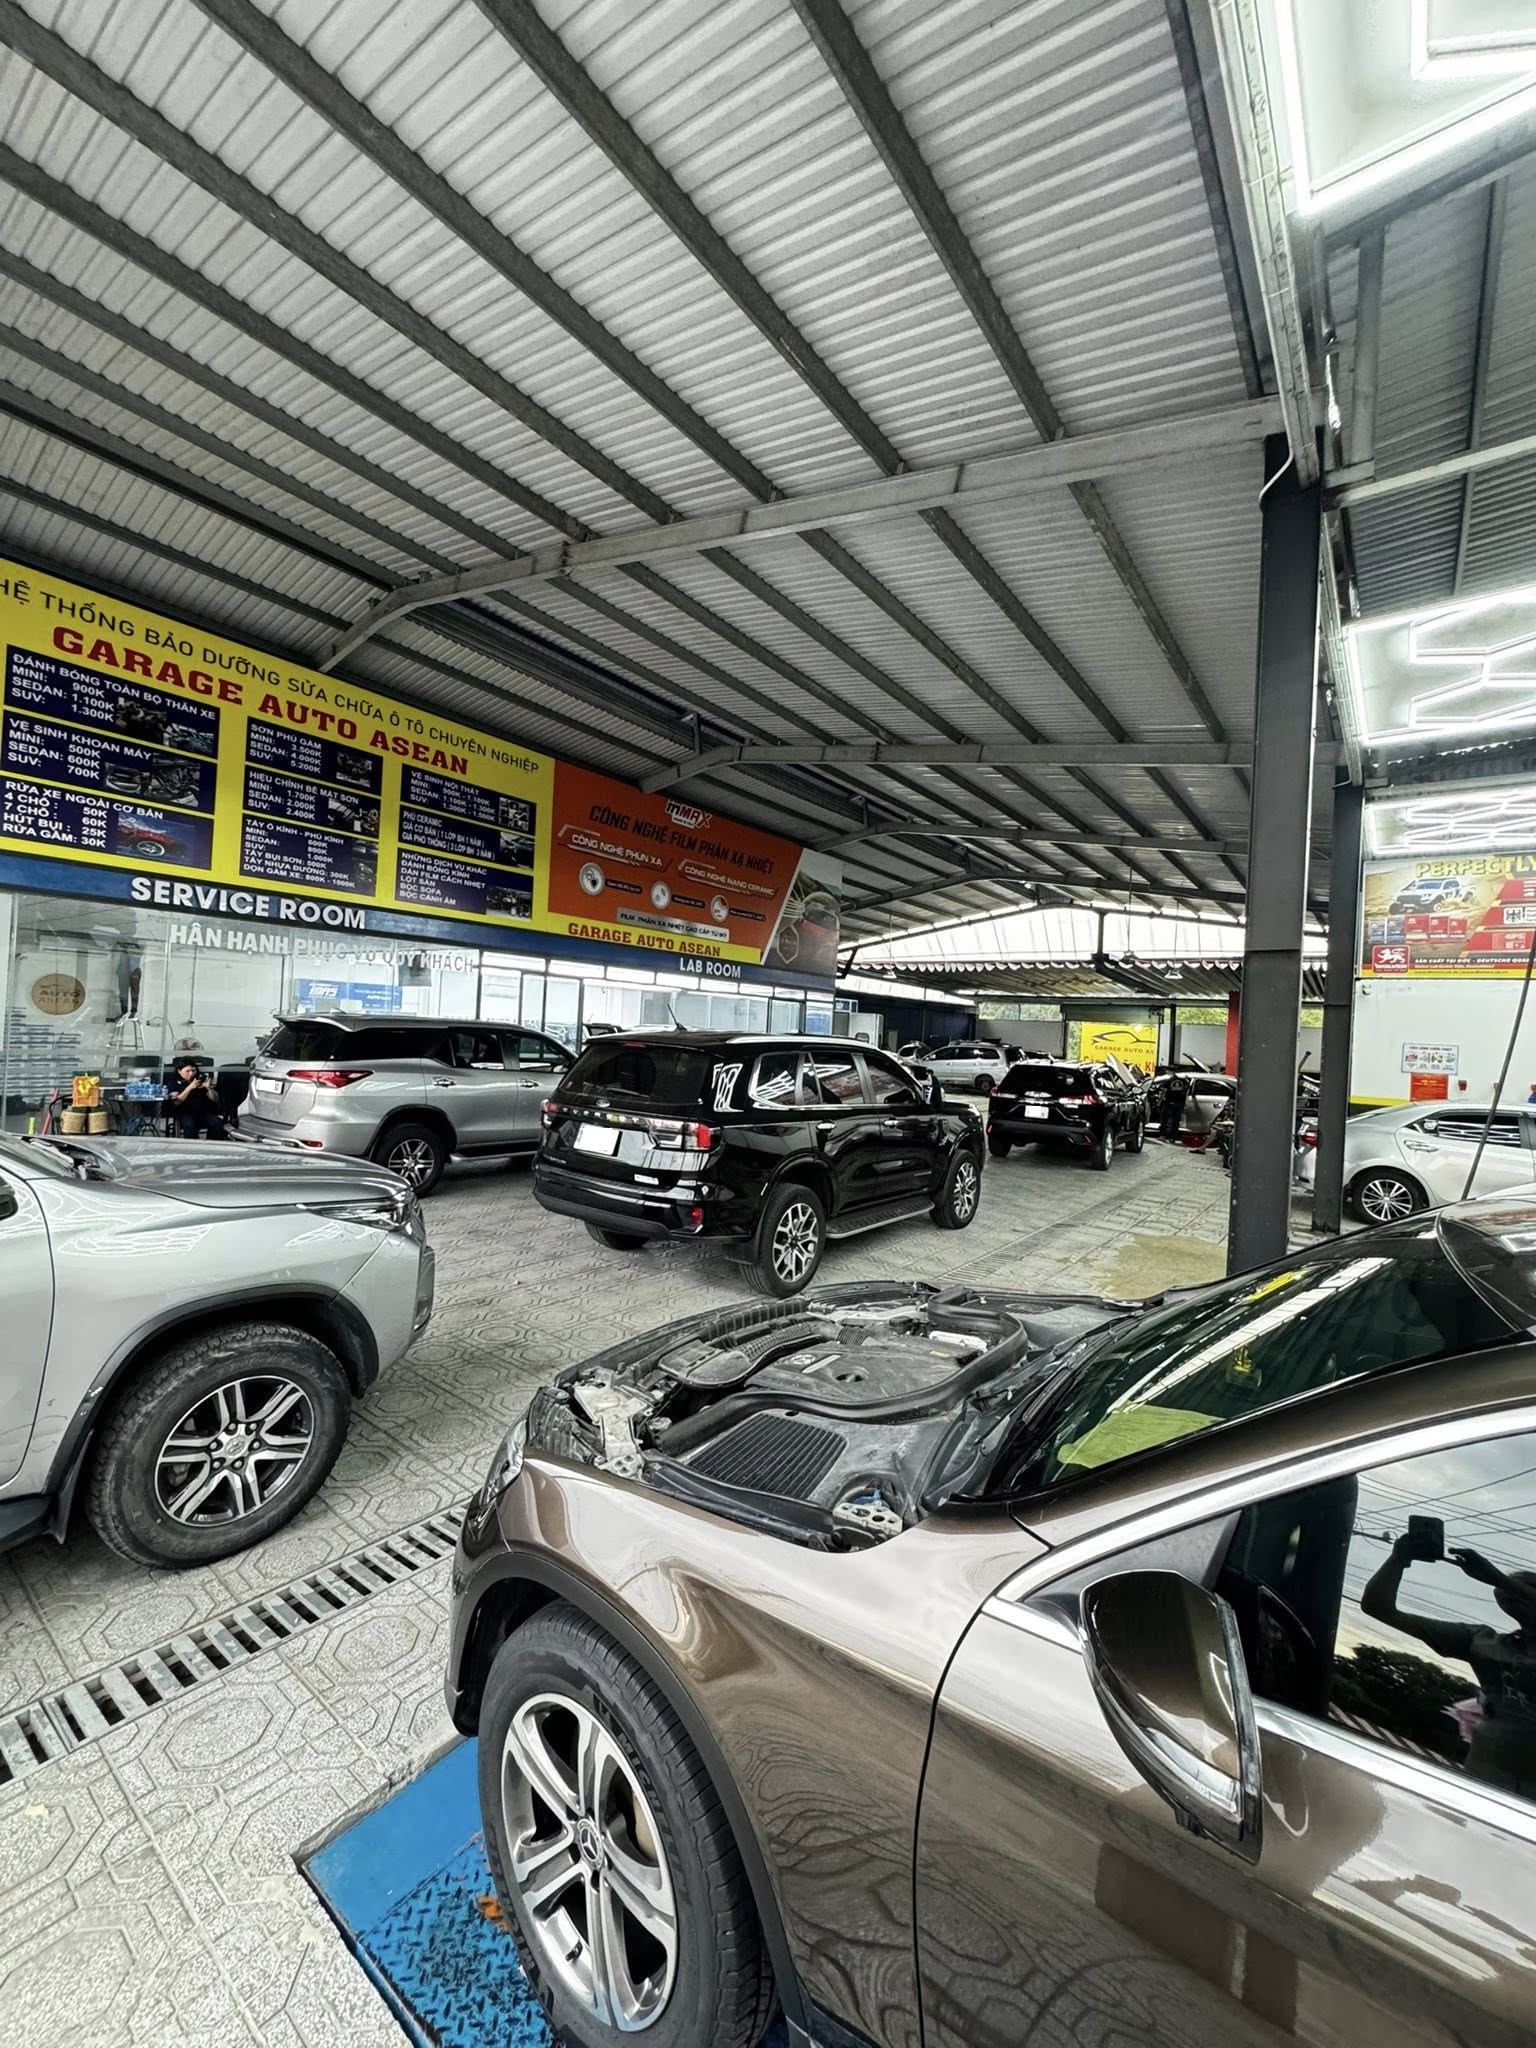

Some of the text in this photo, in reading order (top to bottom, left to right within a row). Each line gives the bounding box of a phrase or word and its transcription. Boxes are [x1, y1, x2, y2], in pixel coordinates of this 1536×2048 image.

[12, 665, 105, 698] MINI: 900K
[12, 676, 115, 712] SEDAN: 1.100K
[13, 653, 55, 673] ĐÁNH
[60, 666, 101, 686] BÓNG
[104, 679, 140, 698] TOÀN
[143, 692, 161, 705] BỘ
[200, 710, 216, 720] XE
[40, 591, 134, 636] THỐNG
[145, 627, 194, 657] BẢO
[202, 648, 280, 686] DƯỠNG
[288, 675, 328, 702] SỬA
[334, 693, 384, 720] CHỮA
[390, 711, 401, 727] Ô
[405, 717, 425, 735] TÔ
[429, 727, 487, 757] CHUYÊN
[491, 747, 540, 774] NGHIỆP
[11, 688, 115, 723] SUV: 1.300K
[53, 626, 468, 776] GARAGE AUTO ASEAN
[9, 718, 152, 760] VỆ SINH KHOAN MÁY
[251, 723, 274, 736] SƠN
[8, 741, 101, 769] SEDAN: 600K
[9, 729, 101, 759] MINI: 500K
[249, 741, 322, 766] SEDAN: 4.000K
[249, 748, 274, 761] SUV:
[250, 732, 322, 758] MINI: 3.500K
[8, 752, 101, 780] SUV: 700K
[5, 780, 164, 820] RỬA XE NGOÀI CƠ BẢN
[248, 780, 273, 793] MINI:
[248, 789, 285, 804] SEDAN:
[4, 792, 14, 800] 4
[82, 807, 108, 819] 50K
[4, 802, 14, 811] 7
[82, 817, 108, 829] 60K
[247, 799, 316, 820] SUV: 2.400K
[3, 822, 37, 836] RỬA
[81, 837, 107, 848] 30K
[4, 812, 107, 838] HÚT BỤI 25K
[589, 805, 630, 831] CÔNG
[632, 819, 668, 845] NGHỆ
[670, 830, 697, 852] FILM
[245, 834, 281, 847] SEDAN:
[1416, 855, 1536, 878] PERFECTLY
[420, 886, 442, 896] SOFA
[727, 877, 747, 889] NANO
[747, 883, 775, 896] CERAMIC
[130, 876, 367, 930] SERVICE ROOM
[170, 923, 221, 948] HÂN
[227, 929, 289, 955] HẠNH
[294, 938, 346, 962] PHỤC
[383, 945, 415, 968] QUÝ
[419, 948, 475, 973] KHÁCH
[568, 922, 722, 958] GARAGE AUTO ASEAN
[680, 957, 741, 979] LAB ROOM
